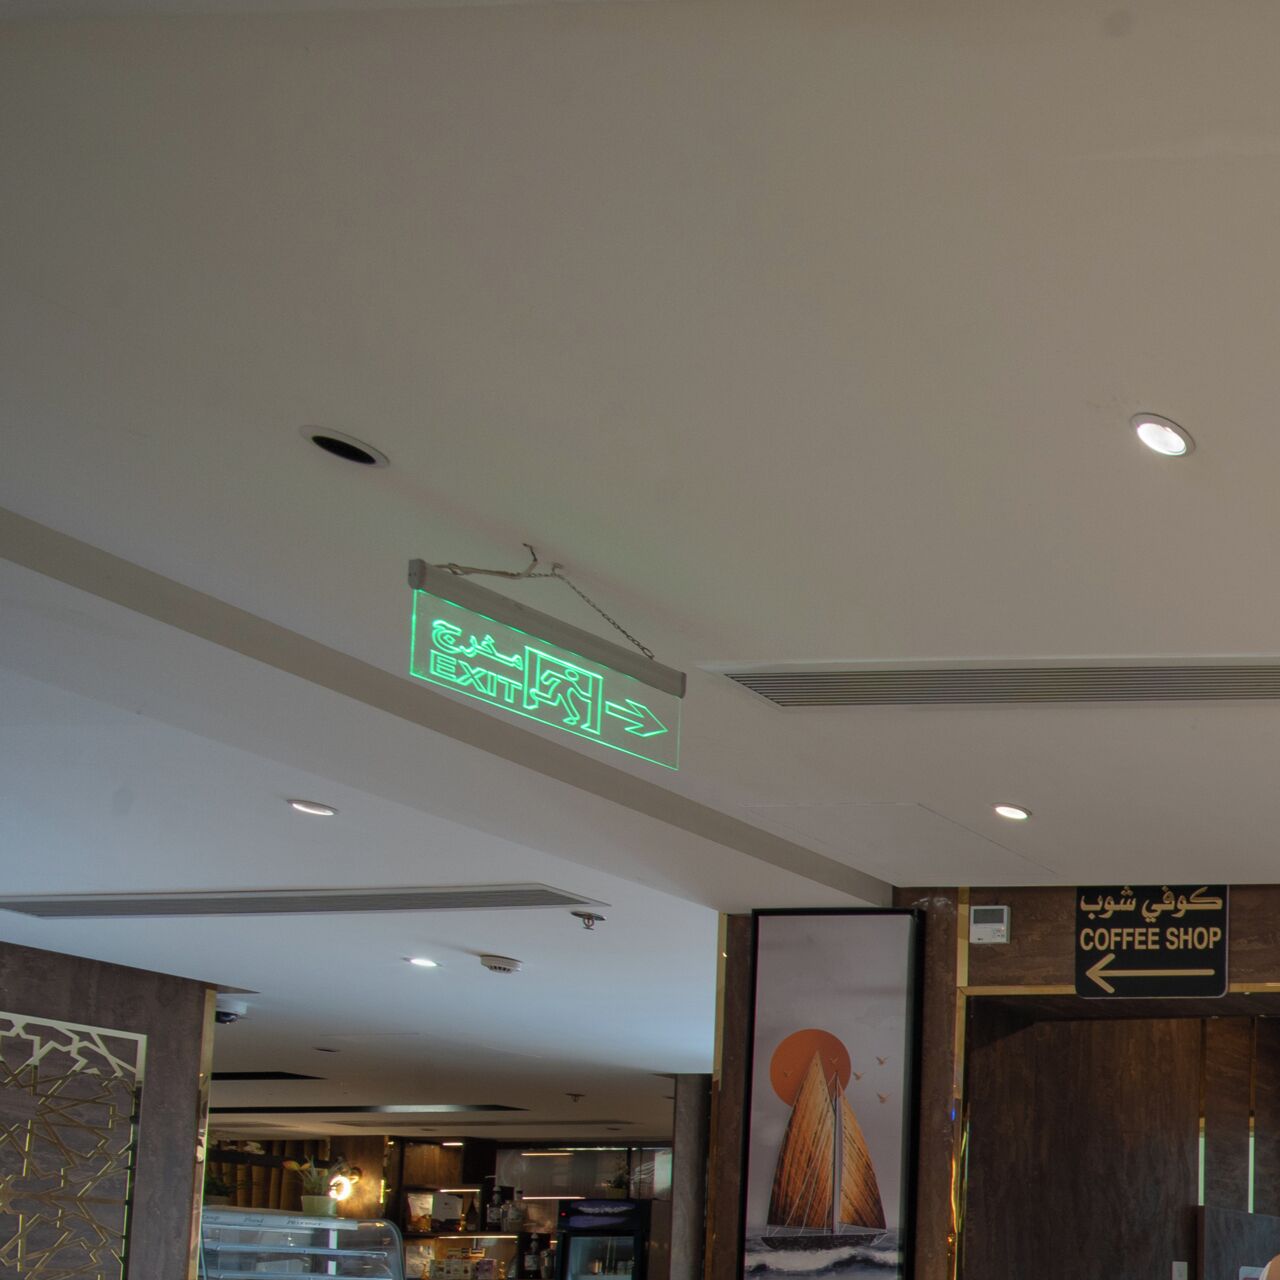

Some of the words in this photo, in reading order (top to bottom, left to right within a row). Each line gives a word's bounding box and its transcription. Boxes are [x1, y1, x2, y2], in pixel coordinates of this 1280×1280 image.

[431, 618, 524, 671] مخرج
[429, 649, 523, 703] EXIT
[1080, 885, 1136, 920] شوب
[1141, 885, 1223, 923] كوفي
[1080, 927, 1160, 950] COFFEE
[1165, 927, 1222, 949] SHOP
